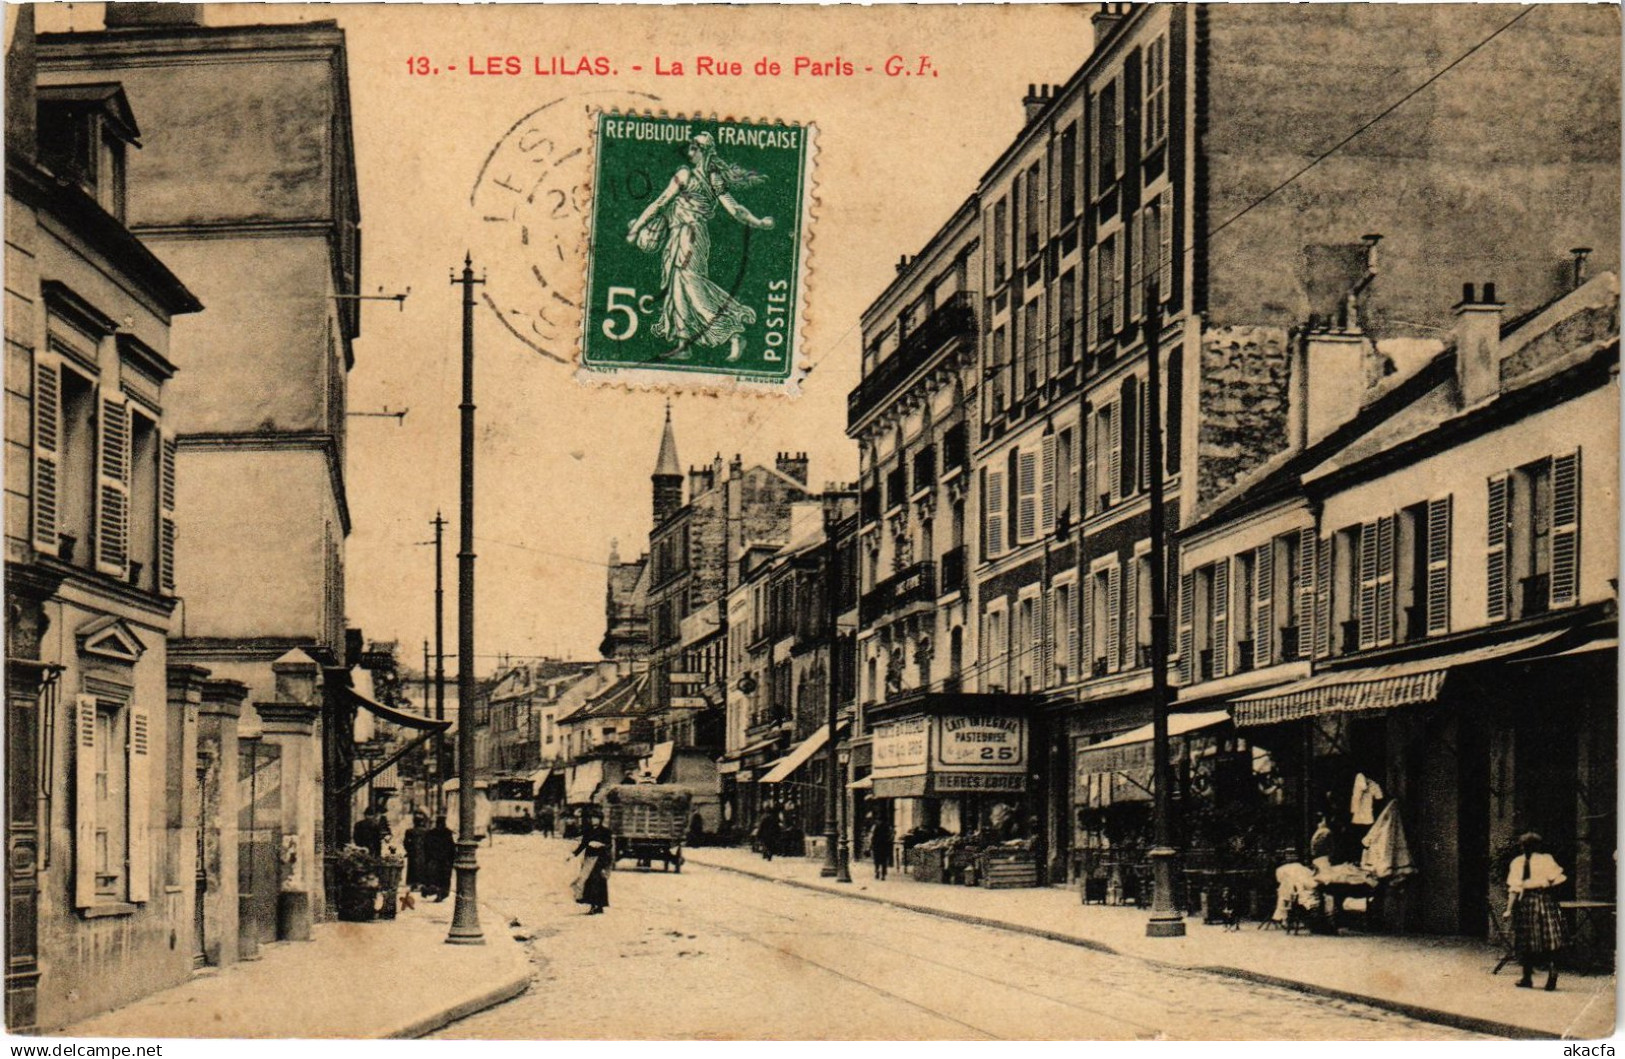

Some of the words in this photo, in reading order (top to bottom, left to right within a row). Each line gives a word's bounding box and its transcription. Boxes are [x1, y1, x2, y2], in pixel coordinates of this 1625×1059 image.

[605, 119, 693, 145] REPUBLIQUE
[717, 126, 798, 150] FRANÇAISE
[762, 278, 789, 363] POSTES
